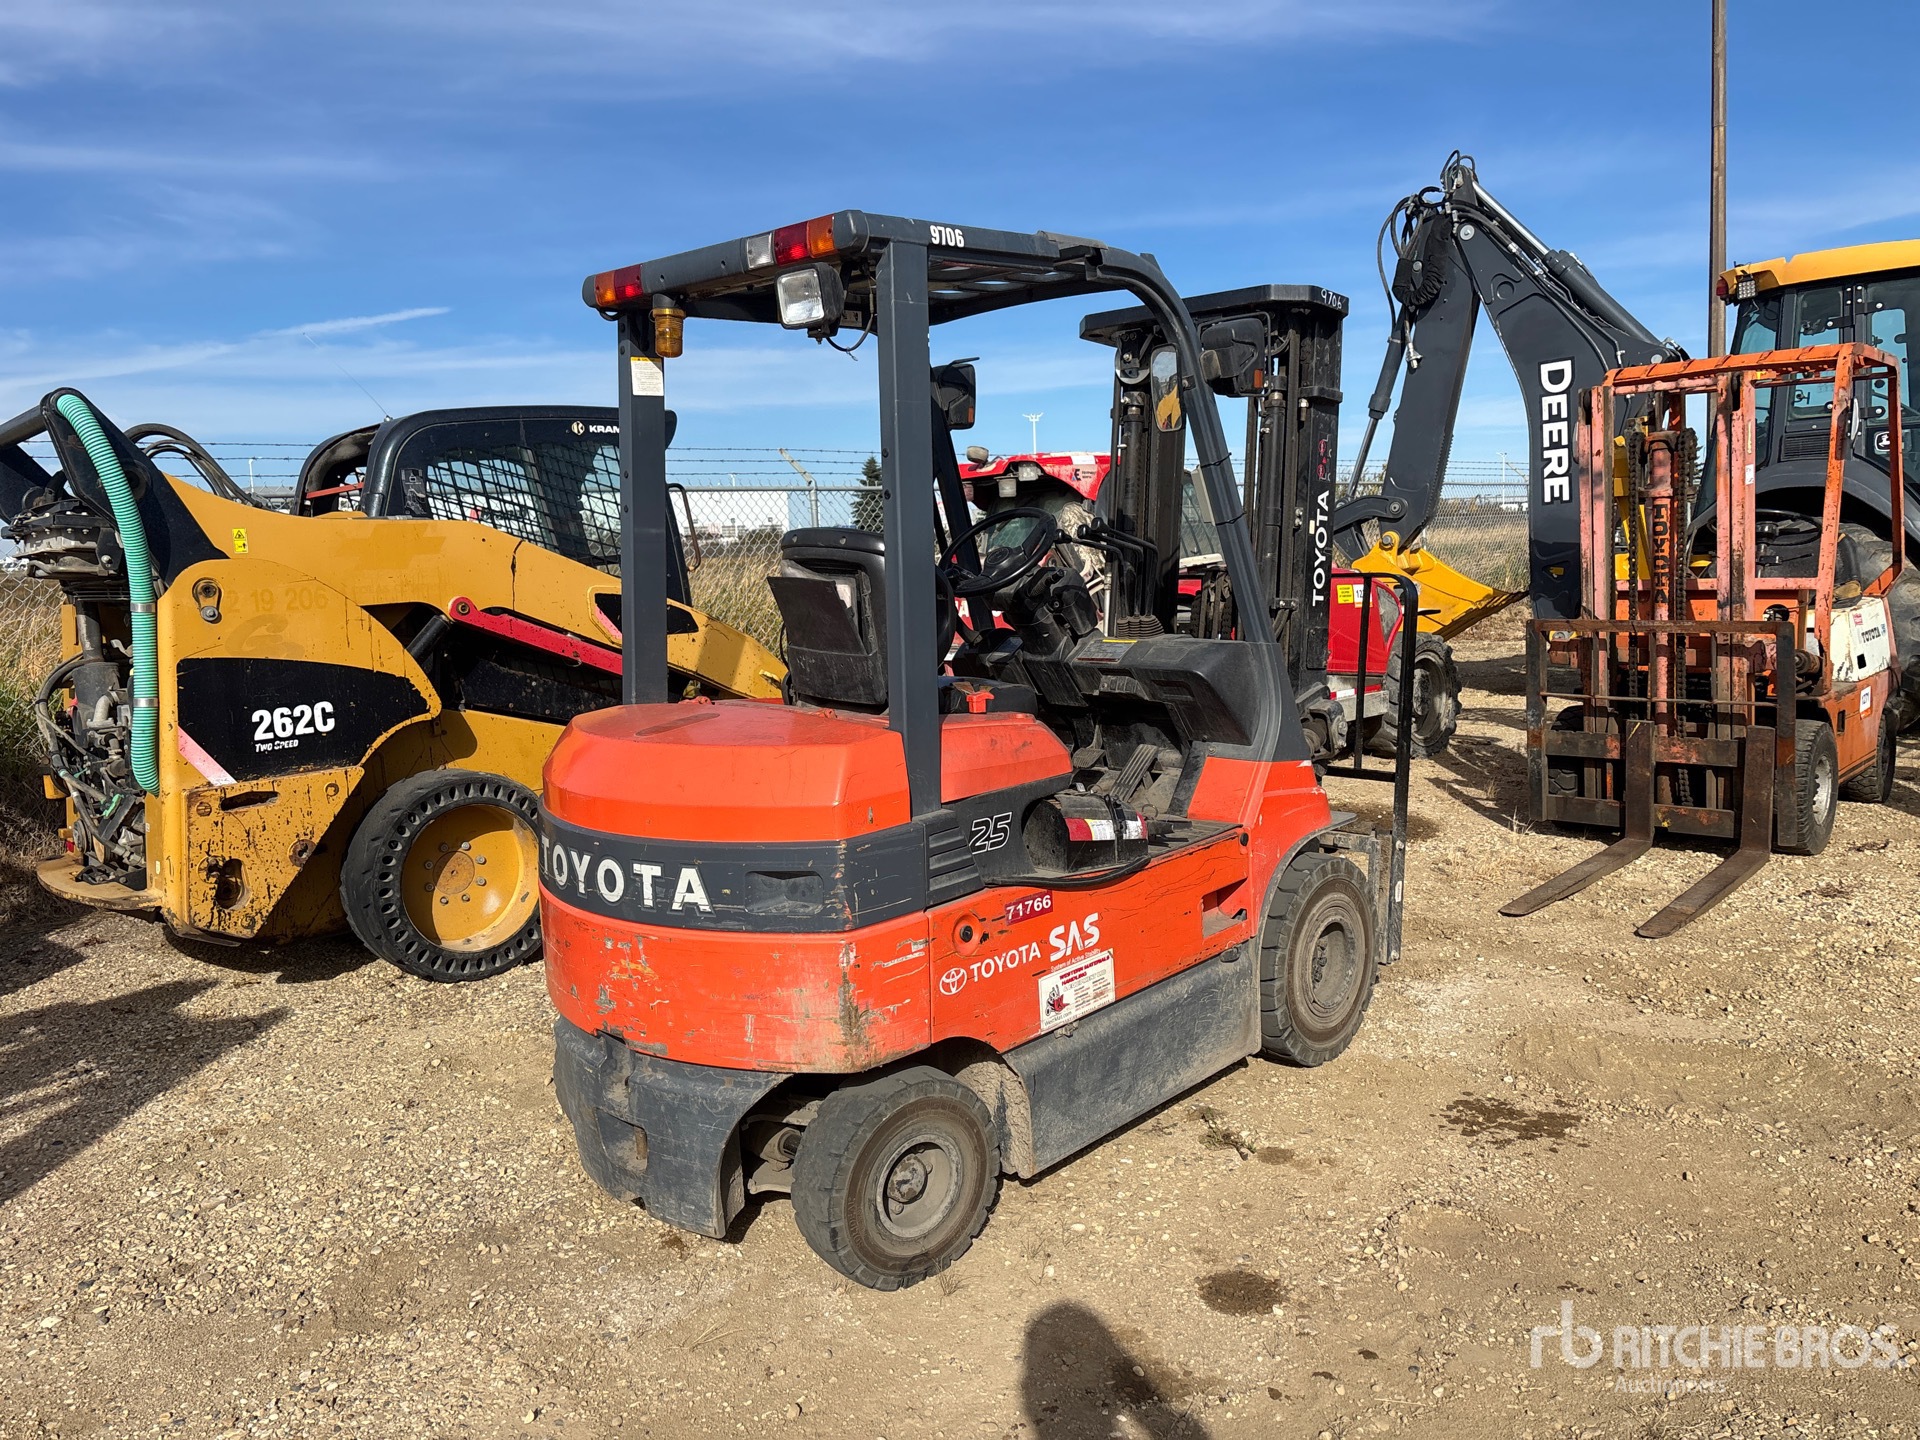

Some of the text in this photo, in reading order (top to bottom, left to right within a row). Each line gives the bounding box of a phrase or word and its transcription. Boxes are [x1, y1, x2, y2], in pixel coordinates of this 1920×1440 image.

[929, 225, 965, 248] 9706
[1320, 288, 1343, 310] 9706
[589, 425, 620, 433] KRAM
[1540, 359, 1572, 503] DEERE
[1312, 489, 1330, 607] TOYOTA
[1652, 503, 1669, 605] TOYOTA
[251, 701, 336, 741] 262C
[255, 740, 299, 753] TWO SPEED
[968, 812, 1013, 855] 25
[541, 834, 712, 913] TOYOTA
[1006, 895, 1051, 920] 71766
[969, 913, 1100, 982] TOYOTA SAS
